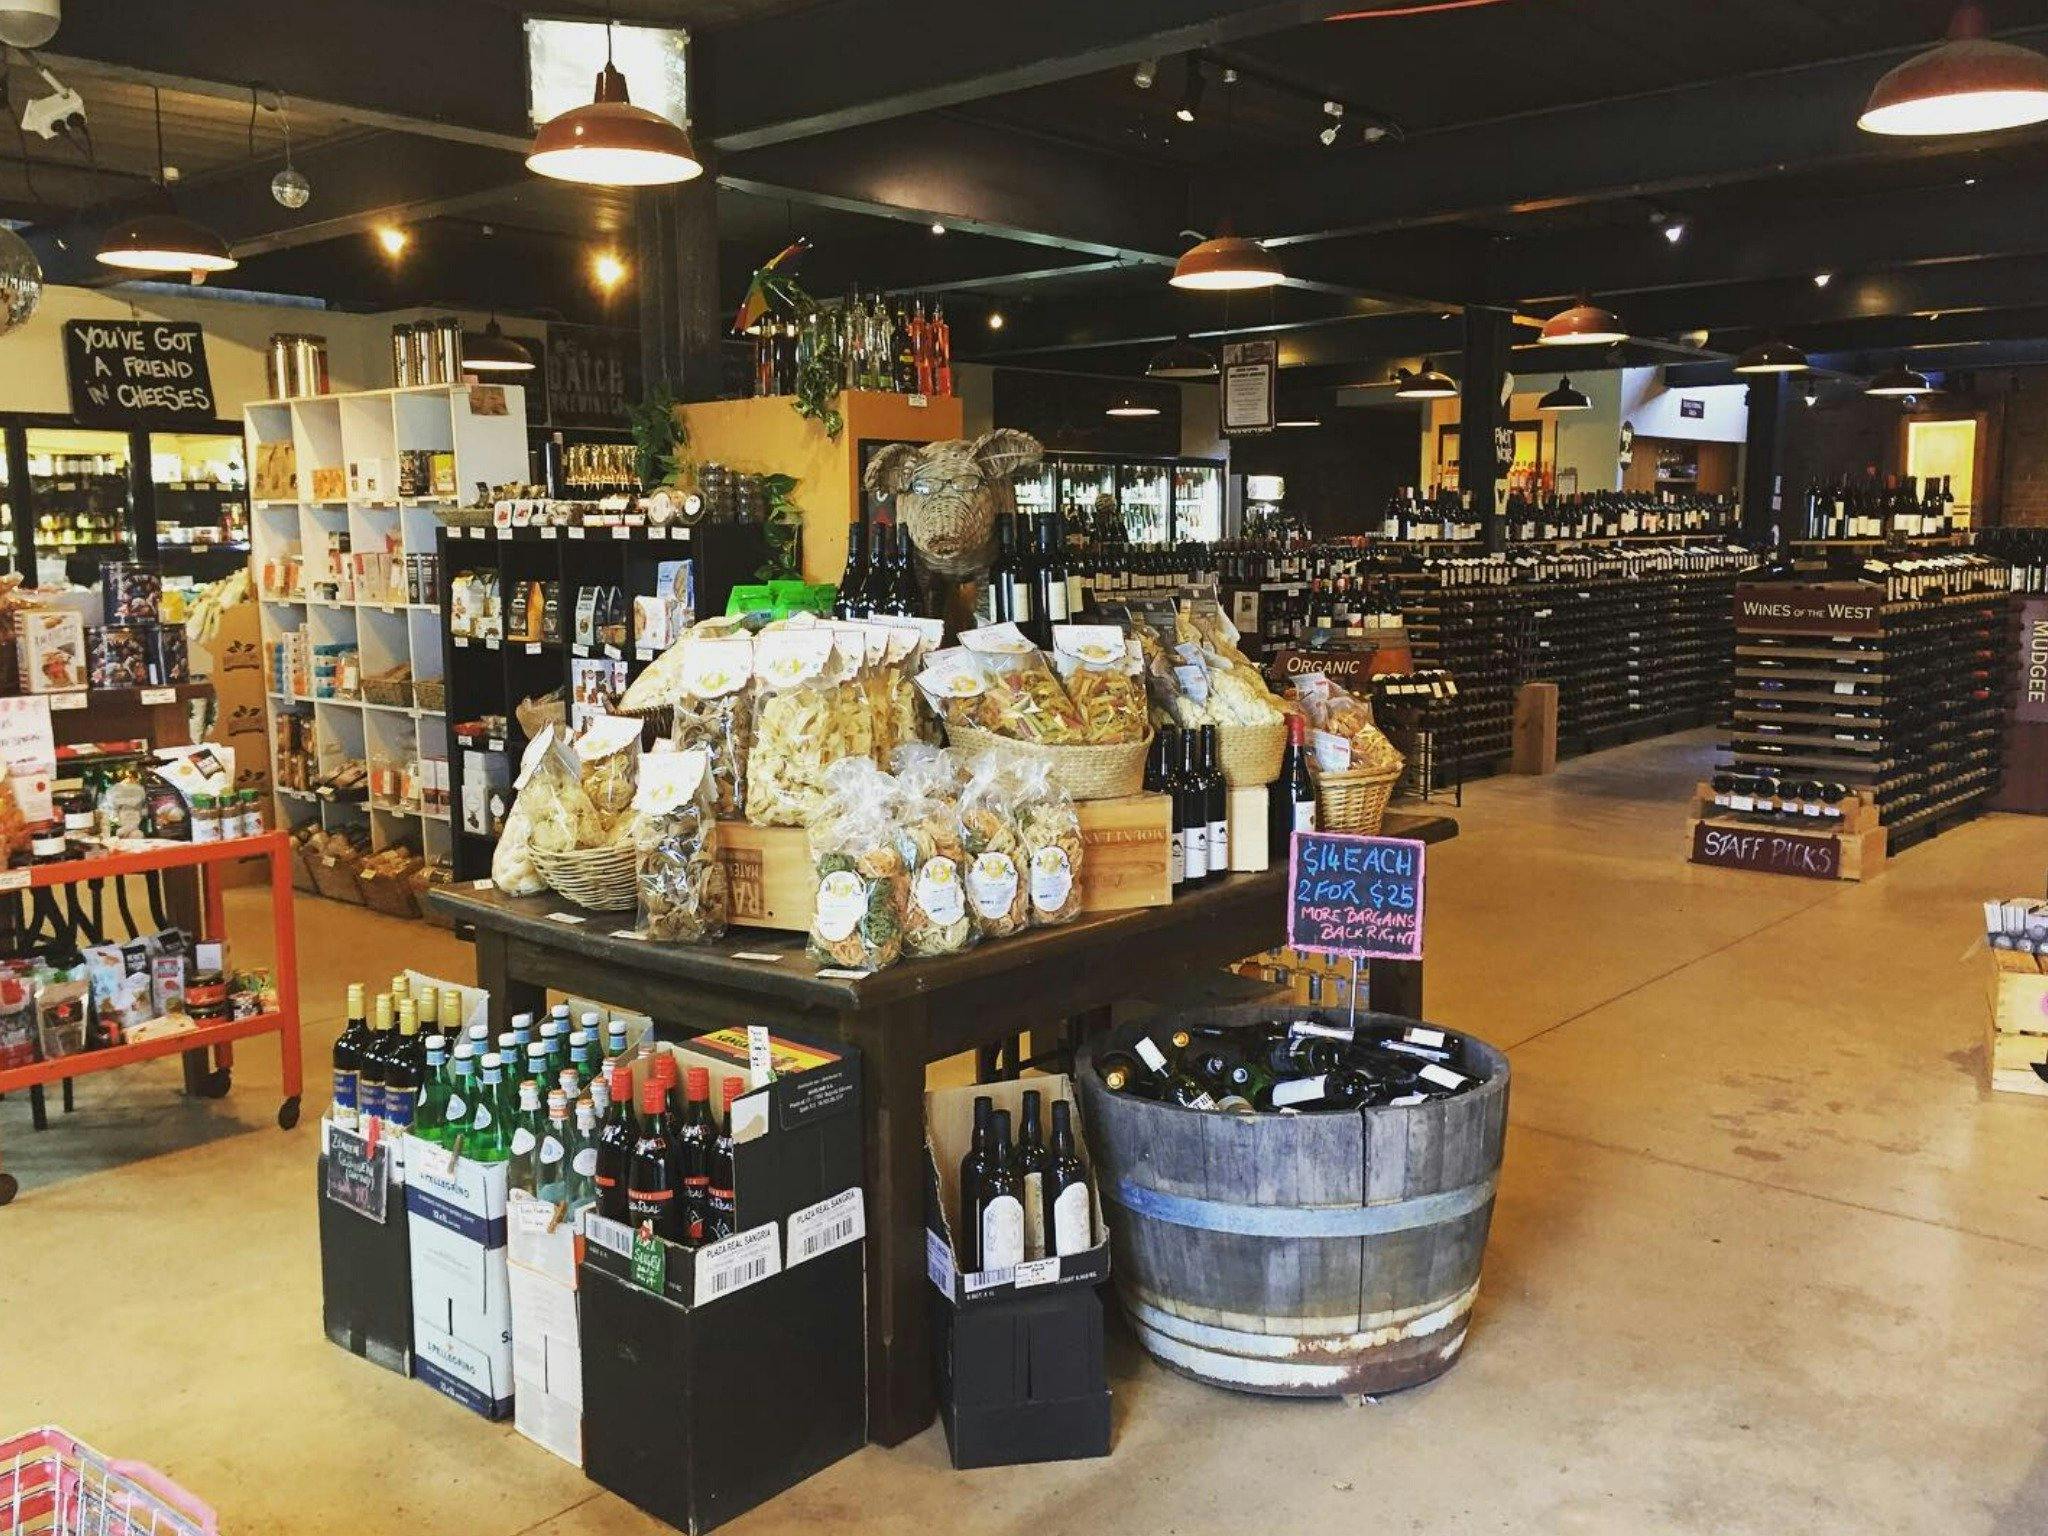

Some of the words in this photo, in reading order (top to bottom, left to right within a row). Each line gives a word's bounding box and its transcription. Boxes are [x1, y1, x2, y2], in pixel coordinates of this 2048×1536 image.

[75, 327, 145, 354] YOU'VE
[154, 327, 198, 353] GOT
[95, 356, 112, 377] A
[123, 356, 193, 378] FRIEND
[117, 384, 211, 411] CHEESES
[1744, 602, 1791, 617] WINES
[1793, 608, 1806, 617] OF
[1807, 609, 1827, 618] THE
[1828, 604, 1873, 620] WEST
[1287, 657, 1360, 675] ORGANIC
[2028, 619, 2048, 703] MUDGEE
[1303, 840, 1340, 876] $14
[1344, 846, 1411, 876] EACH
[1705, 832, 1764, 860] STAFF
[1772, 838, 1832, 874] PICKS
[1298, 879, 1311, 902] 2
[1314, 880, 1360, 905] FOR
[1370, 880, 1414, 910] $25
[1301, 906, 1341, 922] MORE
[1344, 906, 1415, 928] BARGAINS
[1321, 923, 1363, 943] BACK
[815, 1204, 830, 1216] REAL
[706, 1245, 727, 1258] PLAZA
[727, 1239, 743, 1253] REAL
[744, 1228, 771, 1246] SANGRIA
